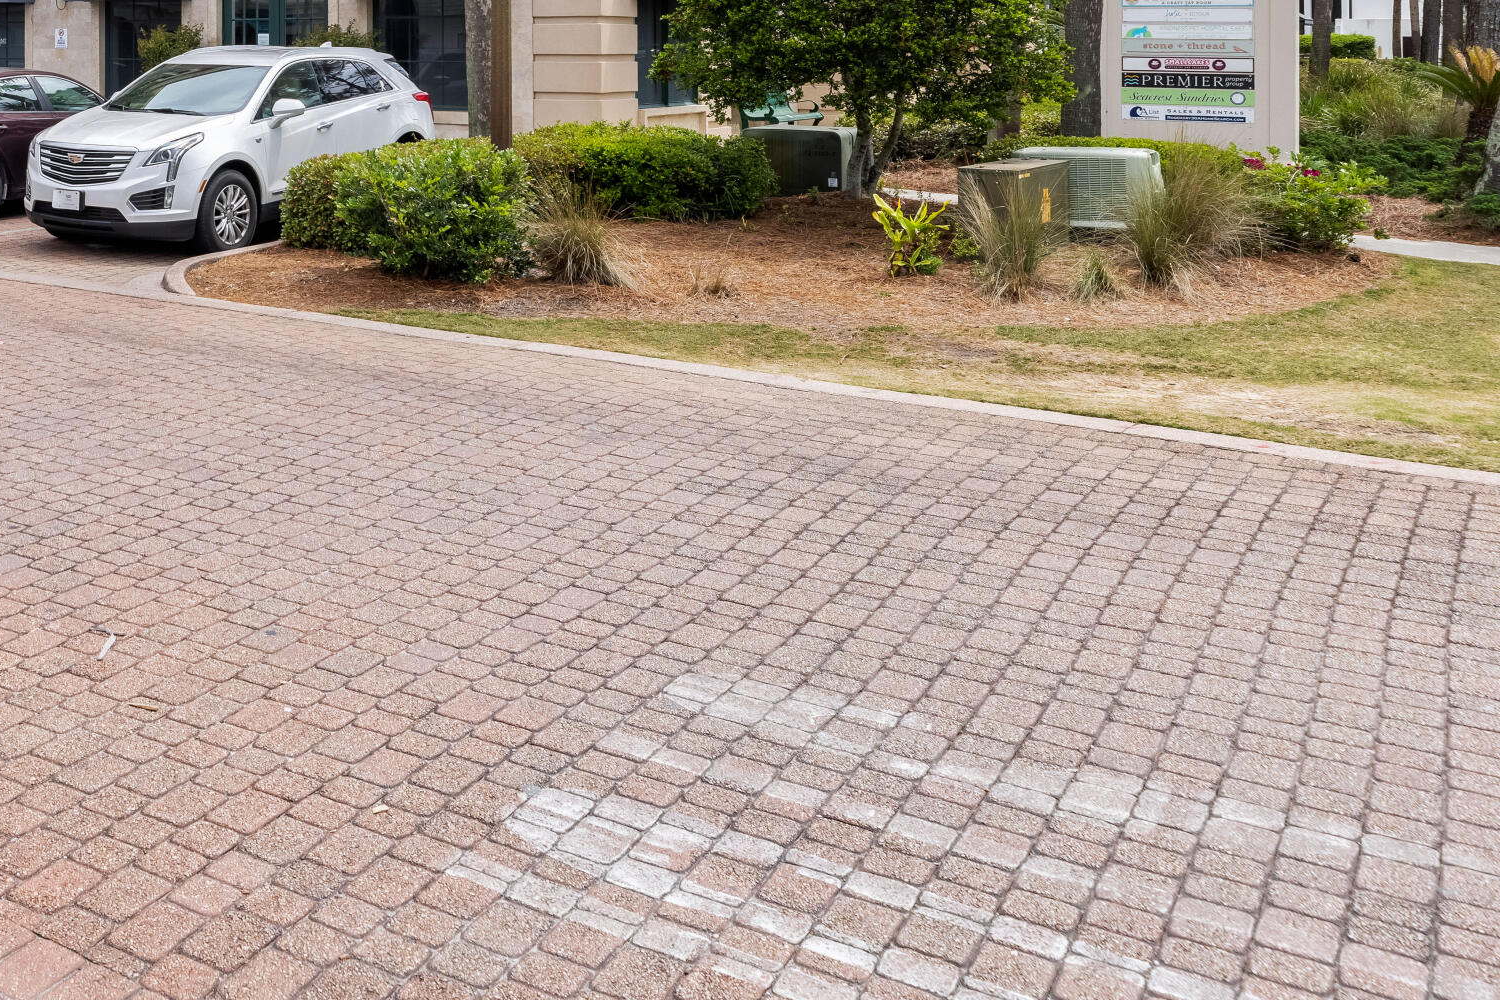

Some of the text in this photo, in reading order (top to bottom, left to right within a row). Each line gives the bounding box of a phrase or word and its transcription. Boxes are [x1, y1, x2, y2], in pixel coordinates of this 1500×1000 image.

[1143, 42, 1174, 50] stone
[1187, 42, 1227, 50] thread
[1164, 58, 1211, 66] SMALLCAKES
[1142, 74, 1224, 87] PREMIER
[1225, 76, 1253, 84] property
[1128, 92, 1226, 102] Seacrest Sundries
